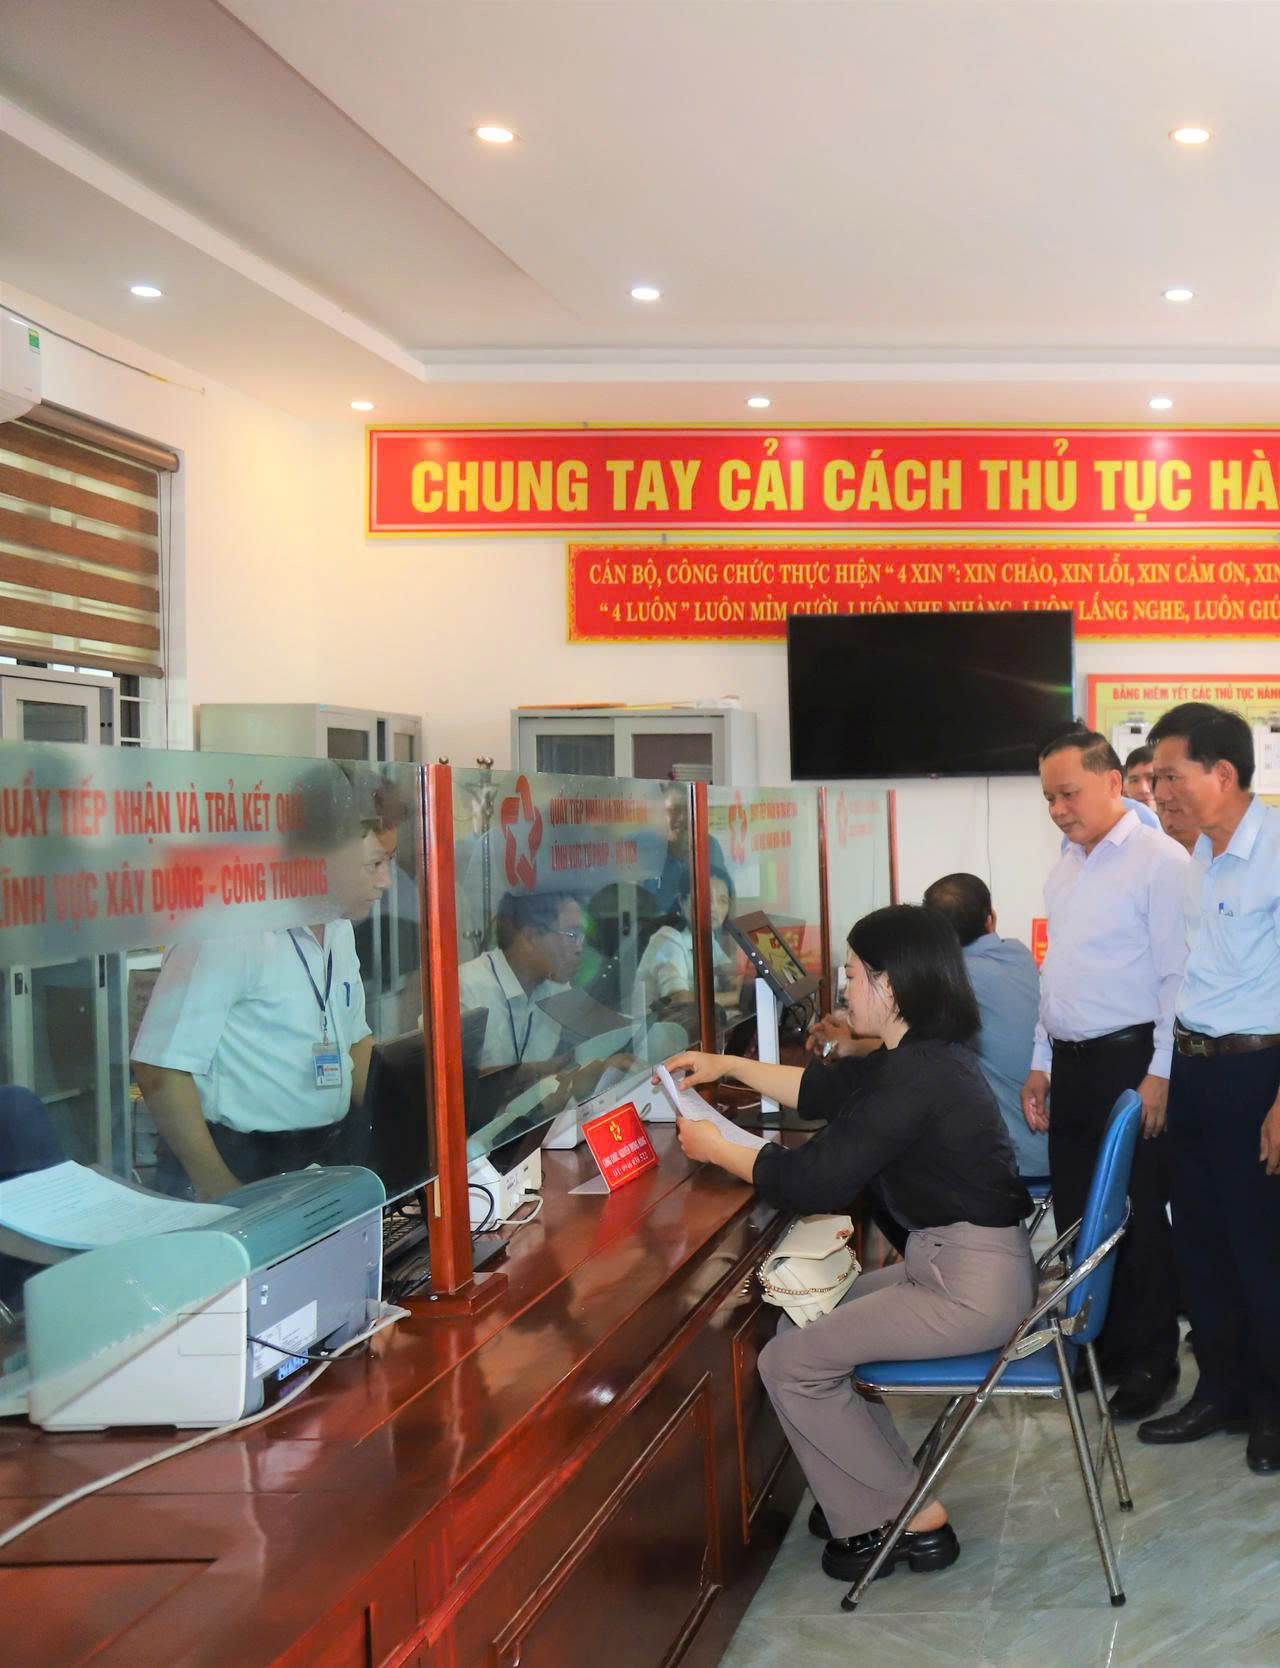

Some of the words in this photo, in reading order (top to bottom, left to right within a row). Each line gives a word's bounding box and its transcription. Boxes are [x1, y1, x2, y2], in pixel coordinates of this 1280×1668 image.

[411, 458, 588, 513] CHUNG
[606, 459, 701, 510] TAY
[719, 437, 804, 511] CẢI
[823, 449, 962, 511] CÁCH
[979, 437, 1077, 511] THỦ
[1094, 459, 1192, 522] TỤC
[589, 559, 627, 585] CÁN
[632, 558, 662, 589] BỘ,
[666, 558, 718, 585] CÔNG
[723, 558, 775, 585] CHỨC
[779, 561, 830, 589] THỰC
[835, 558, 881, 589] HIỆN
[911, 563, 943, 584] XIN
[964, 563, 997, 584] XIN
[1001, 557, 1058, 587] CHÀO,
[1061, 563, 1094, 584] XIN
[1098, 553, 1135, 587] LỖI,
[1137, 563, 1172, 584] XIN
[1175, 555, 1216, 584] CẢM
[1218, 561, 1251, 587] ƠN,
[627, 595, 677, 622] LUÔN
[695, 595, 745, 622] LUÔN
[751, 594, 787, 621] MỈM
[1078, 591, 1129, 622] LẮNG
[1132, 600, 1191, 624] NGHE,
[1194, 593, 1245, 622] LUÔN
[57, 774, 107, 837] TIẾP
[114, 781, 171, 845] NHẬN
[176, 783, 201, 833] VÀ
[204, 778, 238, 833] TRẢ
[242, 780, 271, 832] KẾT
[106, 860, 146, 917] XÂY
[152, 865, 204, 921] DỰNG
[219, 856, 267, 906] CÔNG
